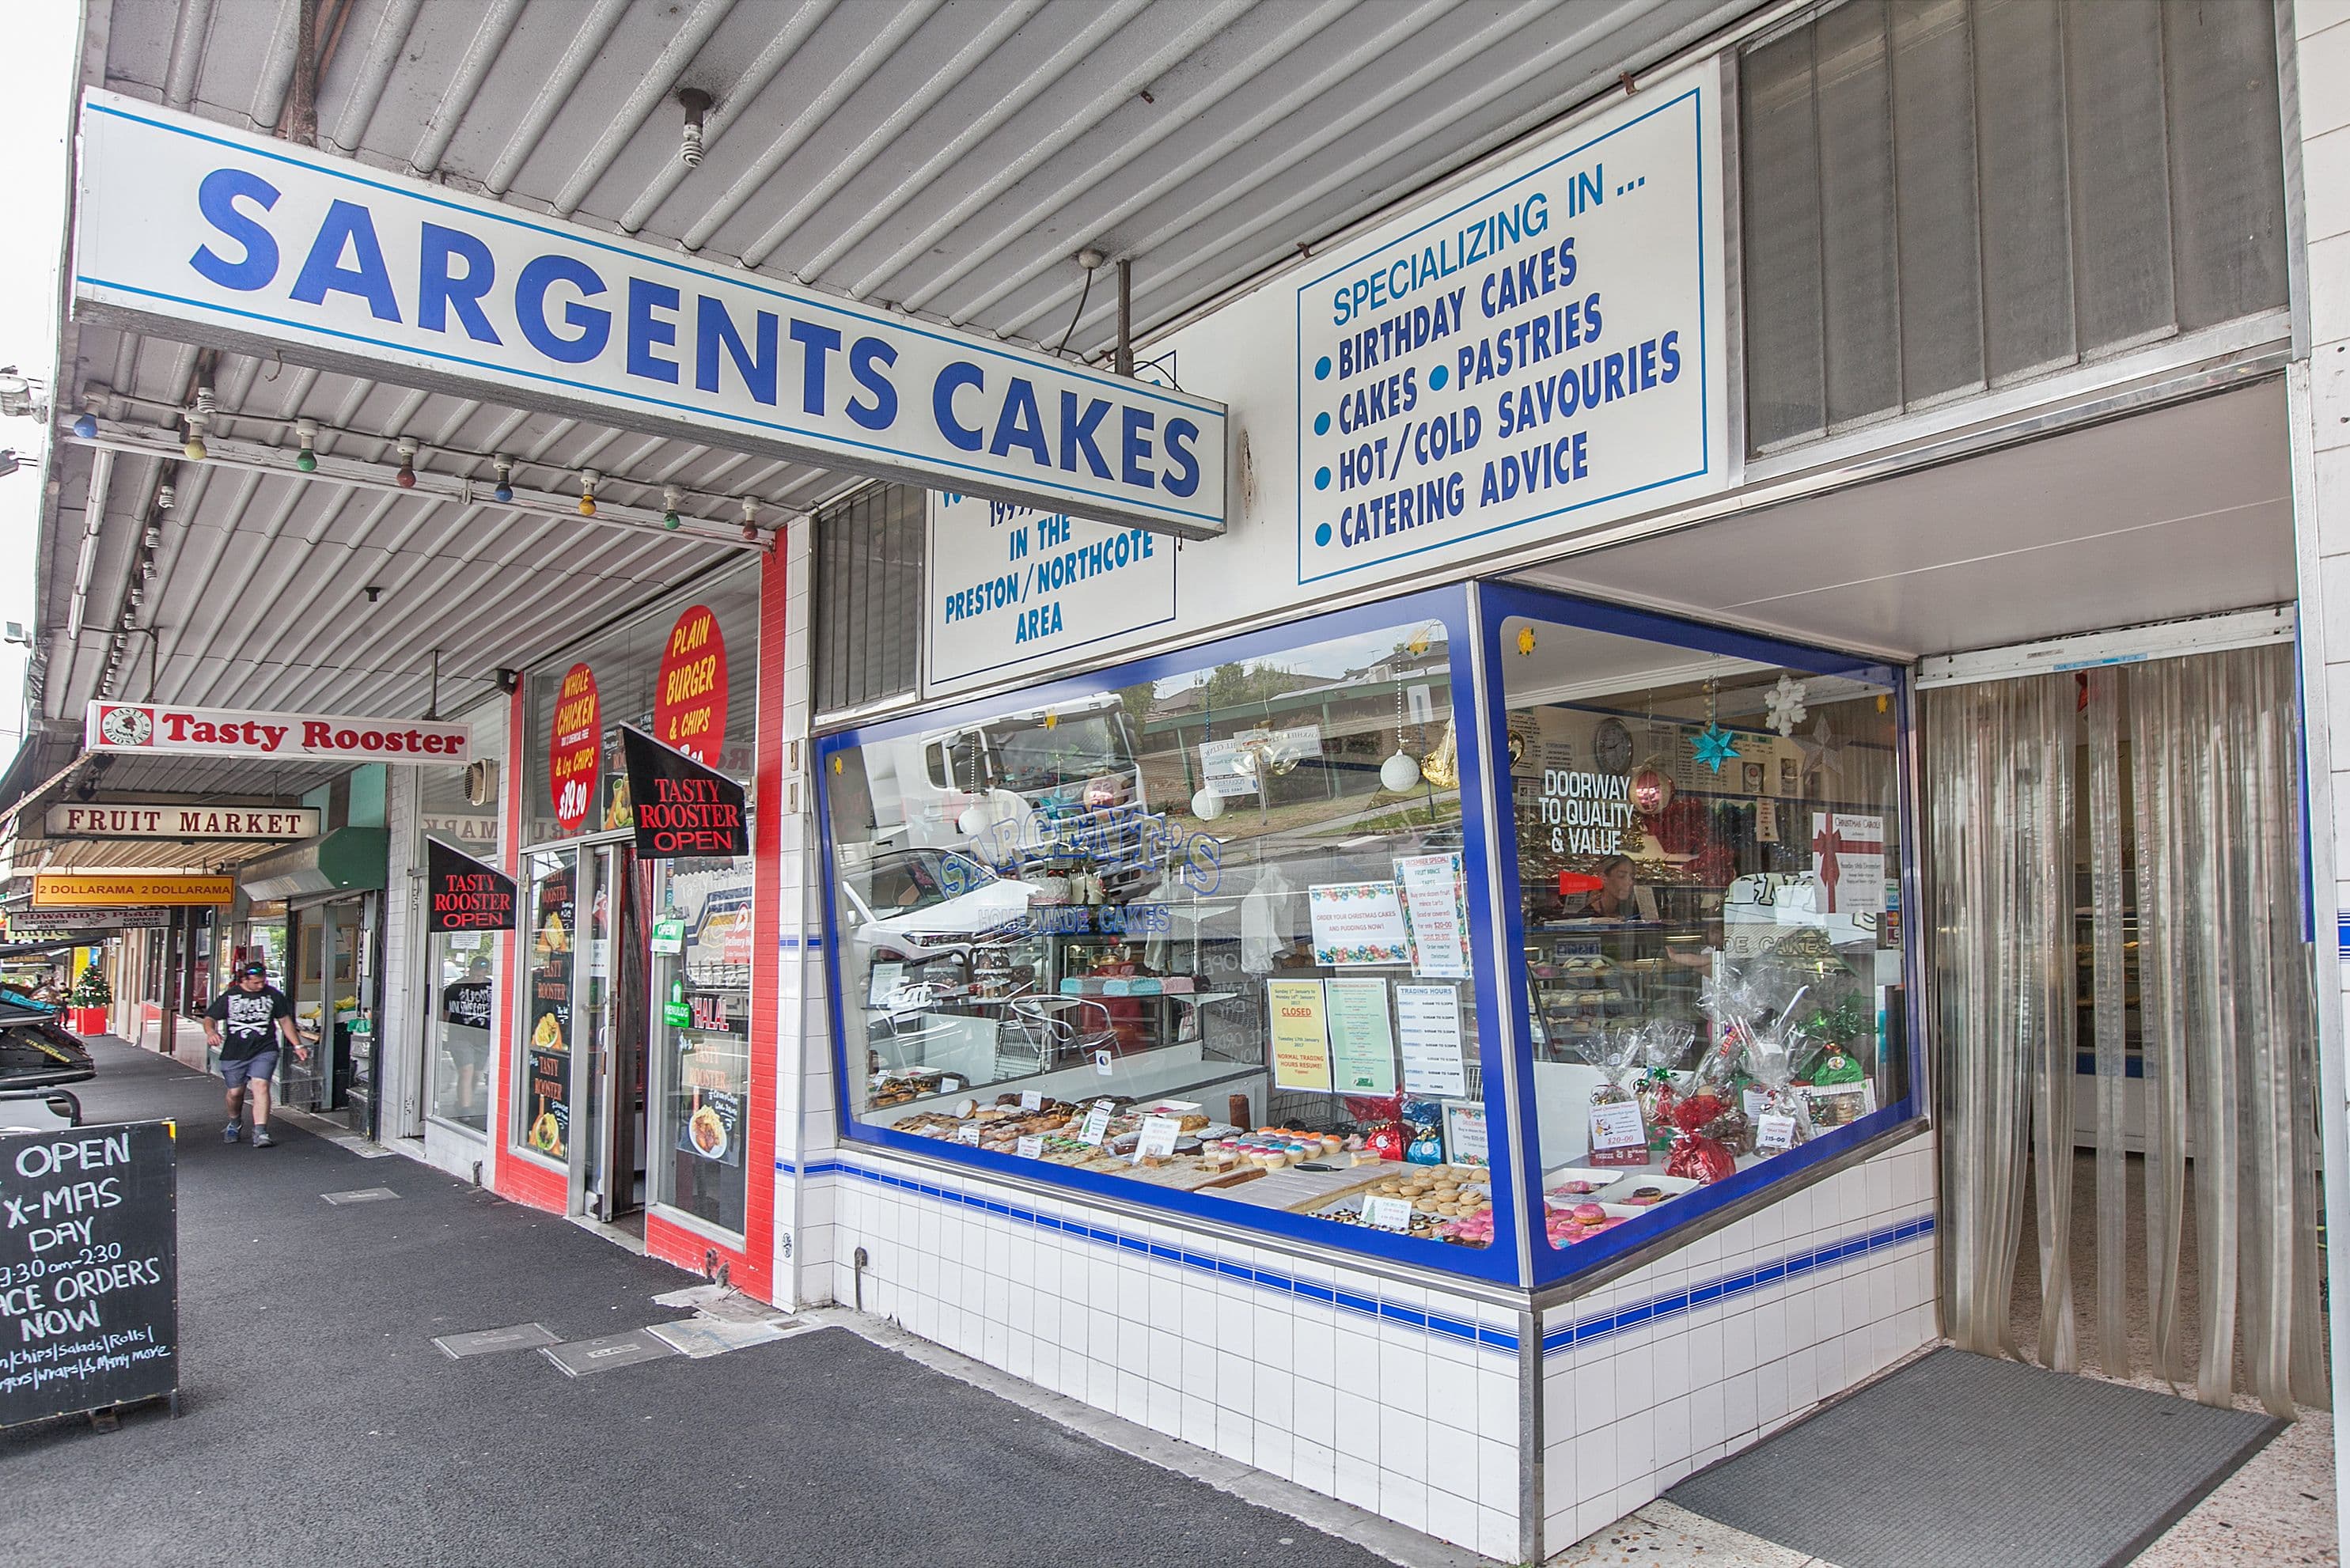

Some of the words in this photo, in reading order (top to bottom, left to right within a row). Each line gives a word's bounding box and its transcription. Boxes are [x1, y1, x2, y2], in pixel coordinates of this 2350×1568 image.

[1333, 191, 1548, 326] SPECIALIZING
[1340, 286, 1466, 381] BIRTHDAY
[1480, 237, 1577, 318] CAKES
[189, 168, 898, 430] SARGENTS
[932, 361, 1200, 498] CAKES
[1340, 367, 1417, 434] CAKES
[1457, 293, 1602, 391] PASTRIES
[1340, 405, 1481, 491] HOT/COLD
[1498, 330, 1681, 438] SAVOURIES
[1340, 472, 1465, 548] CATERING
[1480, 431, 1588, 508] ADVICE
[1010, 528, 1028, 561] IN
[1038, 514, 1071, 550] THE
[946, 530, 1154, 624] PRESTON/NORTHCOTE
[673, 614, 711, 658] PLAIN
[1015, 602, 1063, 644] AREA
[564, 668, 589, 699] WHOLE
[666, 654, 716, 706] BURGER
[557, 694, 595, 737] CHICKEN
[669, 716, 677, 740] &
[681, 706, 711, 737] CHIPS
[162, 713, 289, 752] Tasty
[301, 721, 465, 754] Rooster
[556, 756, 562, 777] &
[573, 747, 594, 772] CHIPS
[559, 778, 587, 820] $19.90
[654, 778, 720, 802] TASTY
[1545, 769, 1631, 801] DOORWAY
[66, 809, 161, 832] FRUIT
[179, 812, 301, 834] MARKET
[639, 804, 741, 828] ROOSTER
[1538, 797, 1561, 825] TO
[1566, 799, 1635, 829] QUALITY
[654, 831, 733, 851] OPEN
[1552, 827, 1564, 853] &
[1568, 828, 1621, 855] VALUE
[1405, 858, 1428, 867] DECEMBER
[1429, 856, 1449, 865] SPECIAL!
[40, 885, 47, 894] 2
[51, 885, 135, 894] DOLLARAMA
[141, 885, 149, 894] 2
[151, 885, 230, 894] DOLLARAMA
[445, 873, 497, 892] TASTY
[434, 892, 510, 911] ROOSTER
[443, 912, 502, 928] OPEN
[657, 924, 677, 936] OPEN
[978, 907, 1028, 933] HOME
[1036, 906, 1090, 933] MADE
[1098, 905, 1170, 934] CAKES
[1758, 936, 1832, 955] CAKES
[665, 1003, 688, 1018] MENULOG
[694, 997, 730, 1032] HALAL
[1282, 1007, 1312, 1017] CLOSED
[539, 1056, 559, 1077] TASTY
[694, 1044, 720, 1064] TASTY
[534, 1078, 563, 1101] ROOSTER
[688, 1068, 726, 1089] ROOSTER
[15, 1132, 131, 1178] OPEN
[3, 1177, 122, 1229] X-MAS
[28, 1216, 94, 1252] DAY
[54, 1257, 161, 1302] ORDERS
[21, 1300, 101, 1342] NOW
